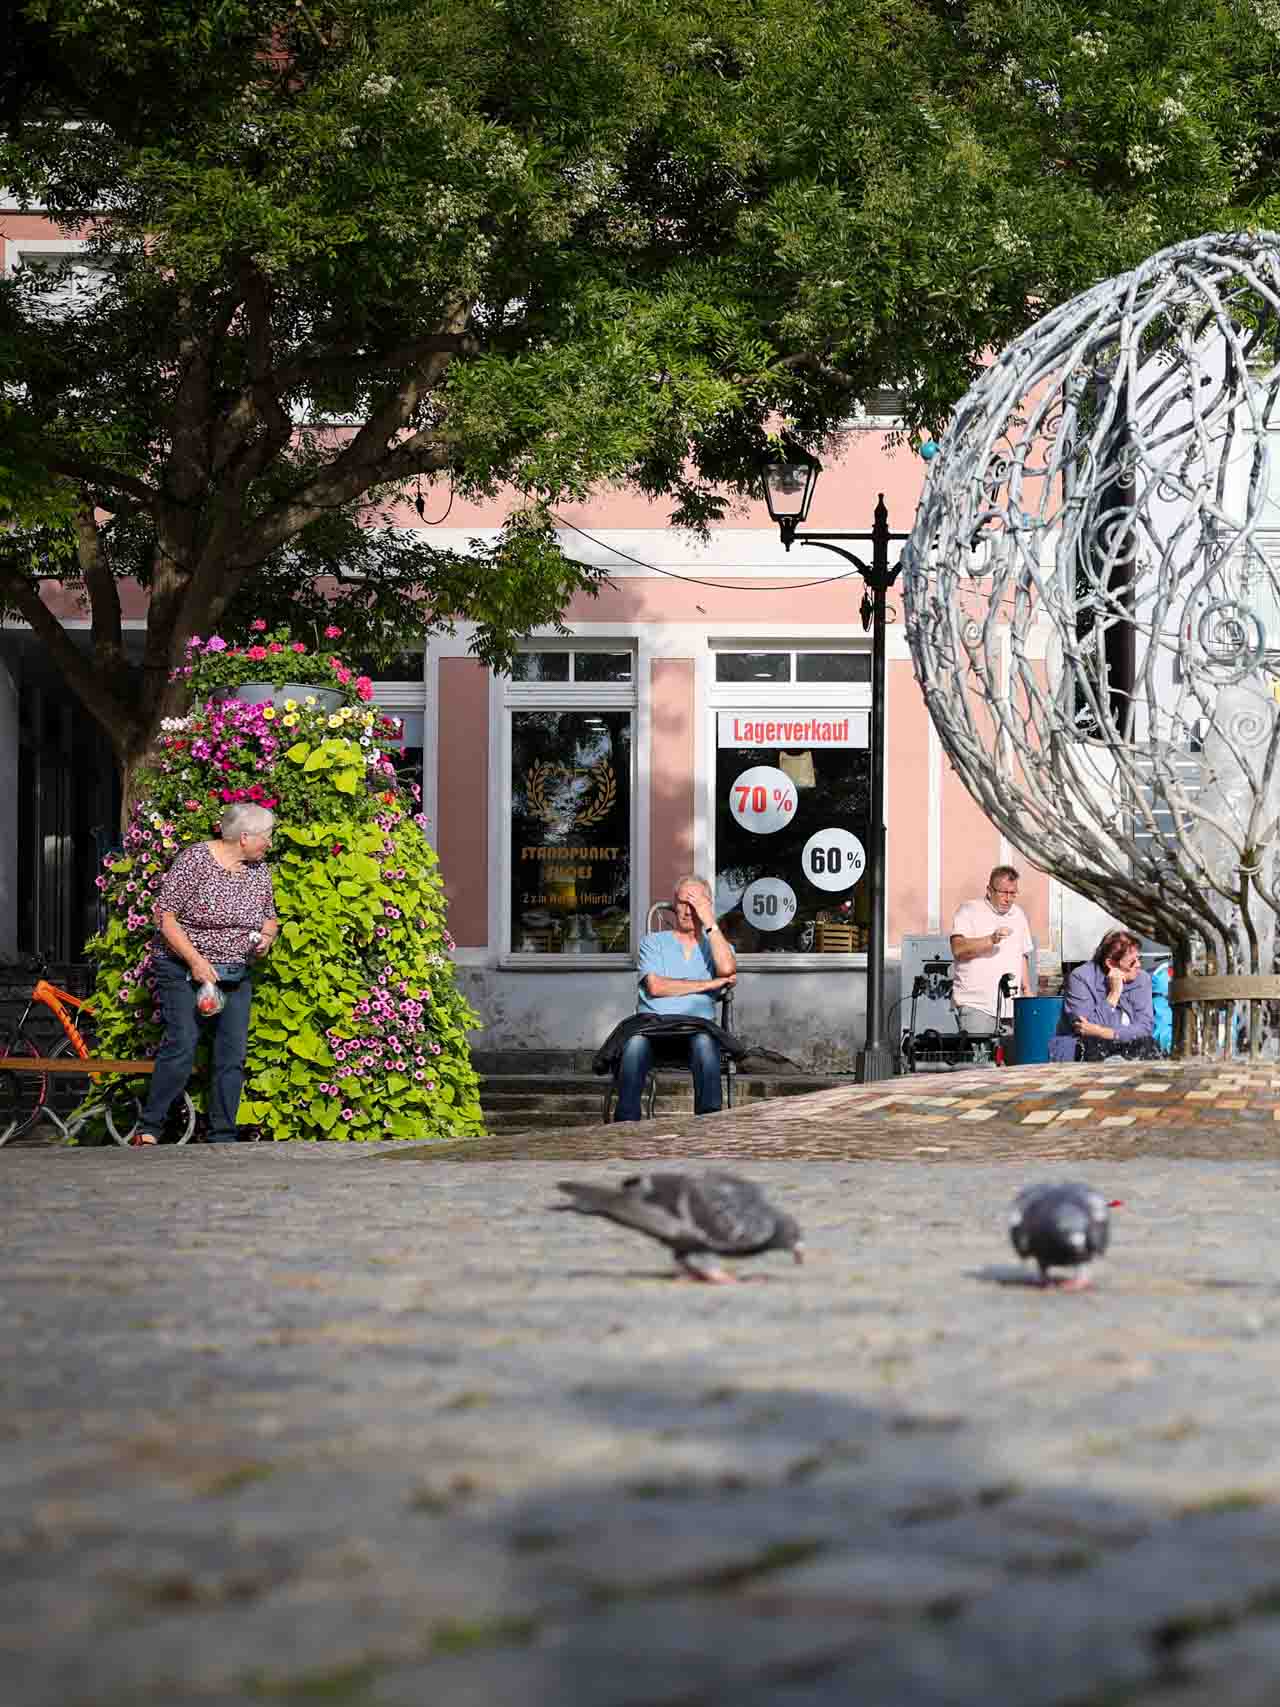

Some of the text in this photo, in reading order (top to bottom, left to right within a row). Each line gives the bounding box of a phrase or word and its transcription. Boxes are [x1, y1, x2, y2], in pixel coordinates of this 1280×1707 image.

[734, 719, 849, 743] Lagerverkauf
[735, 787, 767, 813] 70
[811, 848, 841, 874] 60
[753, 895, 777, 916] 50
